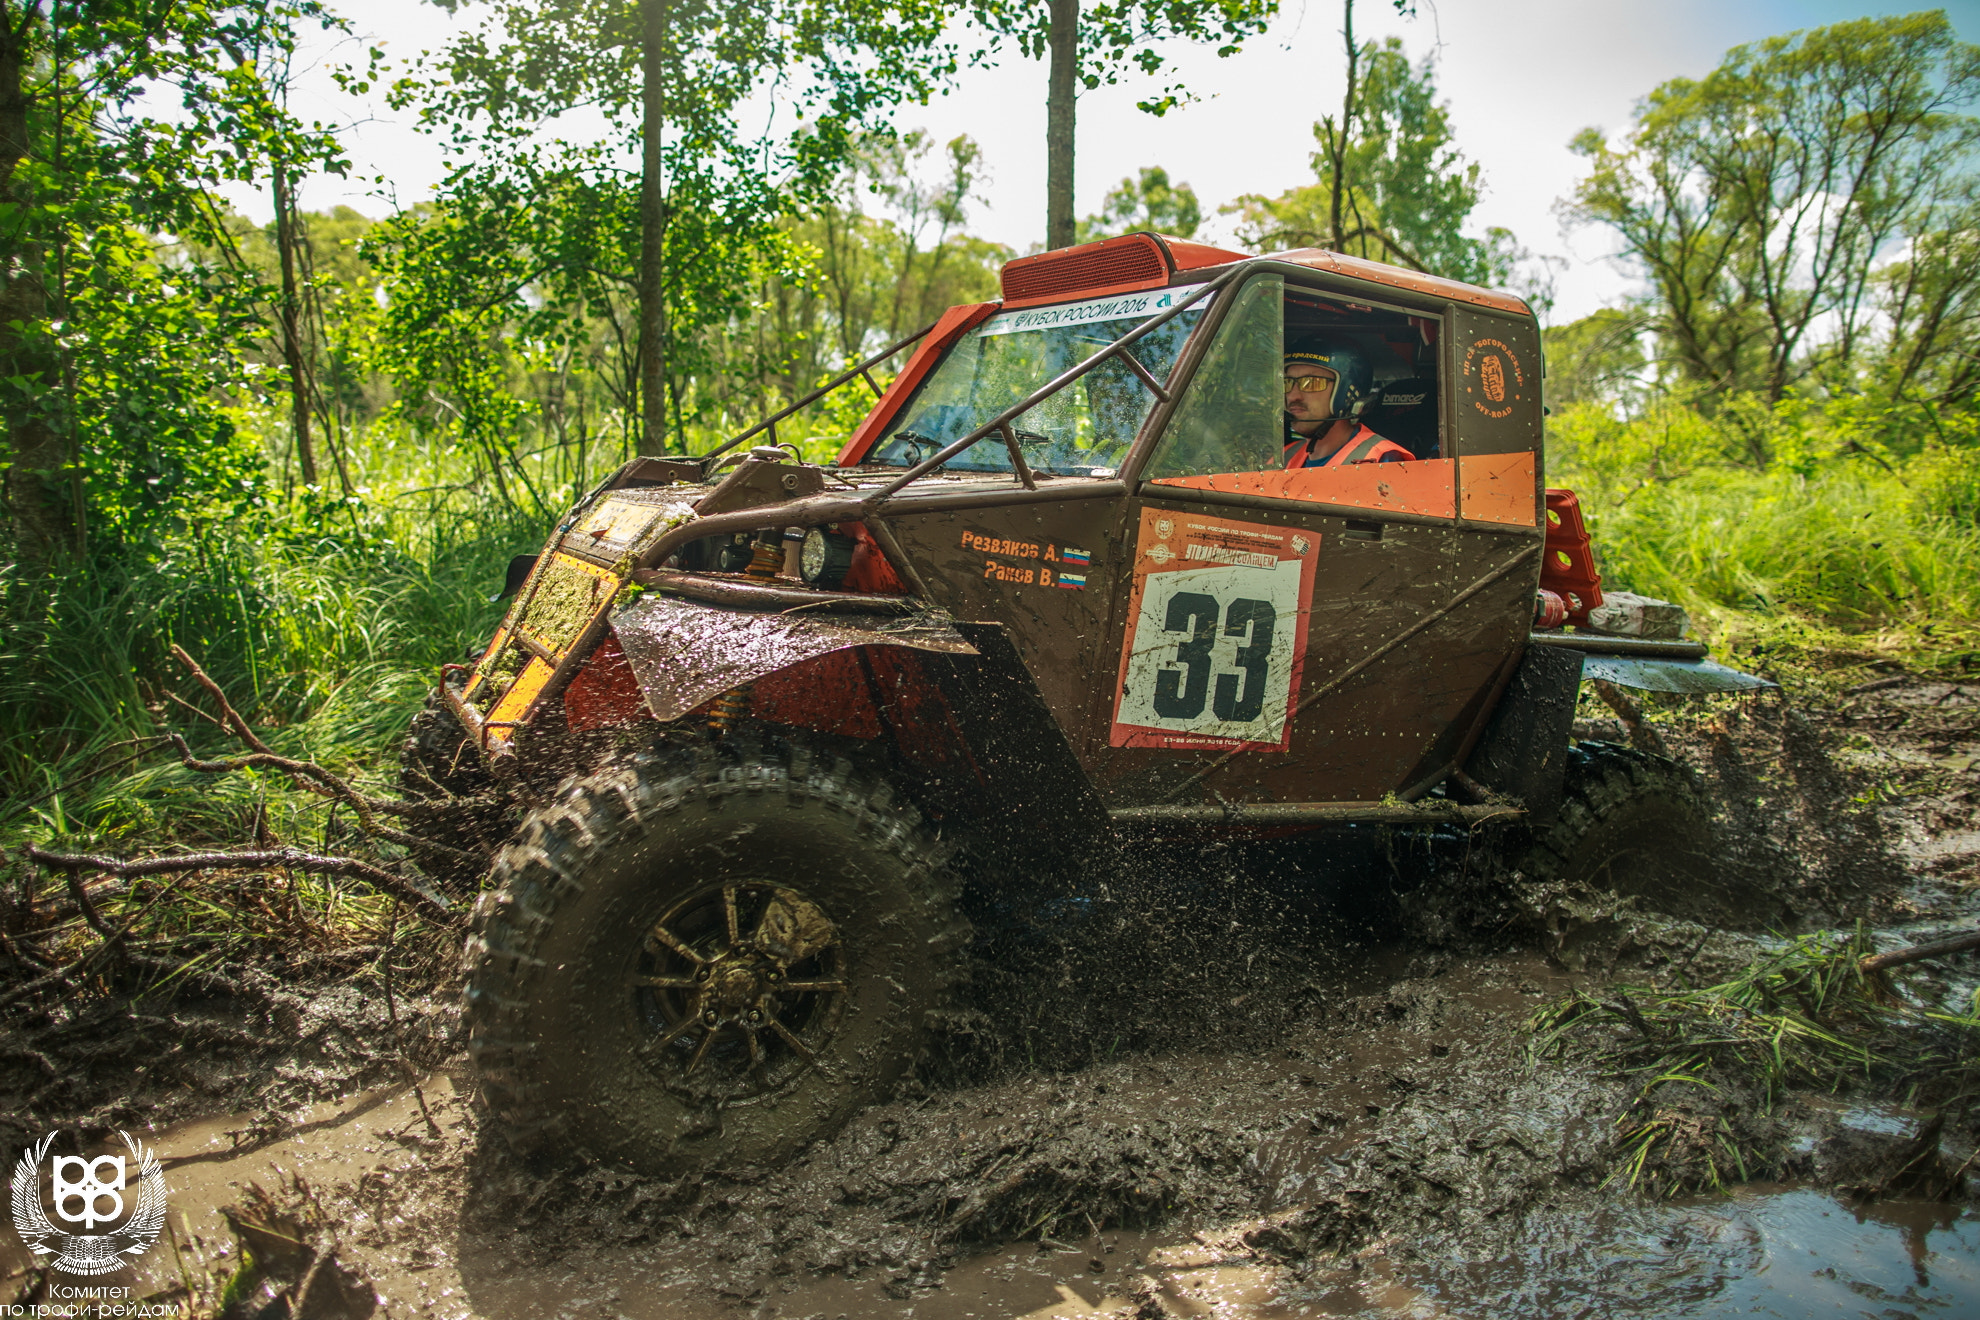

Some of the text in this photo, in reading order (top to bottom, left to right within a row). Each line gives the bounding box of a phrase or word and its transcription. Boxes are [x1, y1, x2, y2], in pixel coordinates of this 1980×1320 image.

[1024, 310, 1065, 326] КУБОК
[1063, 302, 1118, 321] РОССИИ
[1115, 297, 1150, 315] 2016
[1475, 401, 1512, 418] OFF-ROAD
[961, 530, 1060, 563] Резвяков А.
[984, 560, 1056, 587] Раков В.
[1152, 591, 1277, 722] 33
